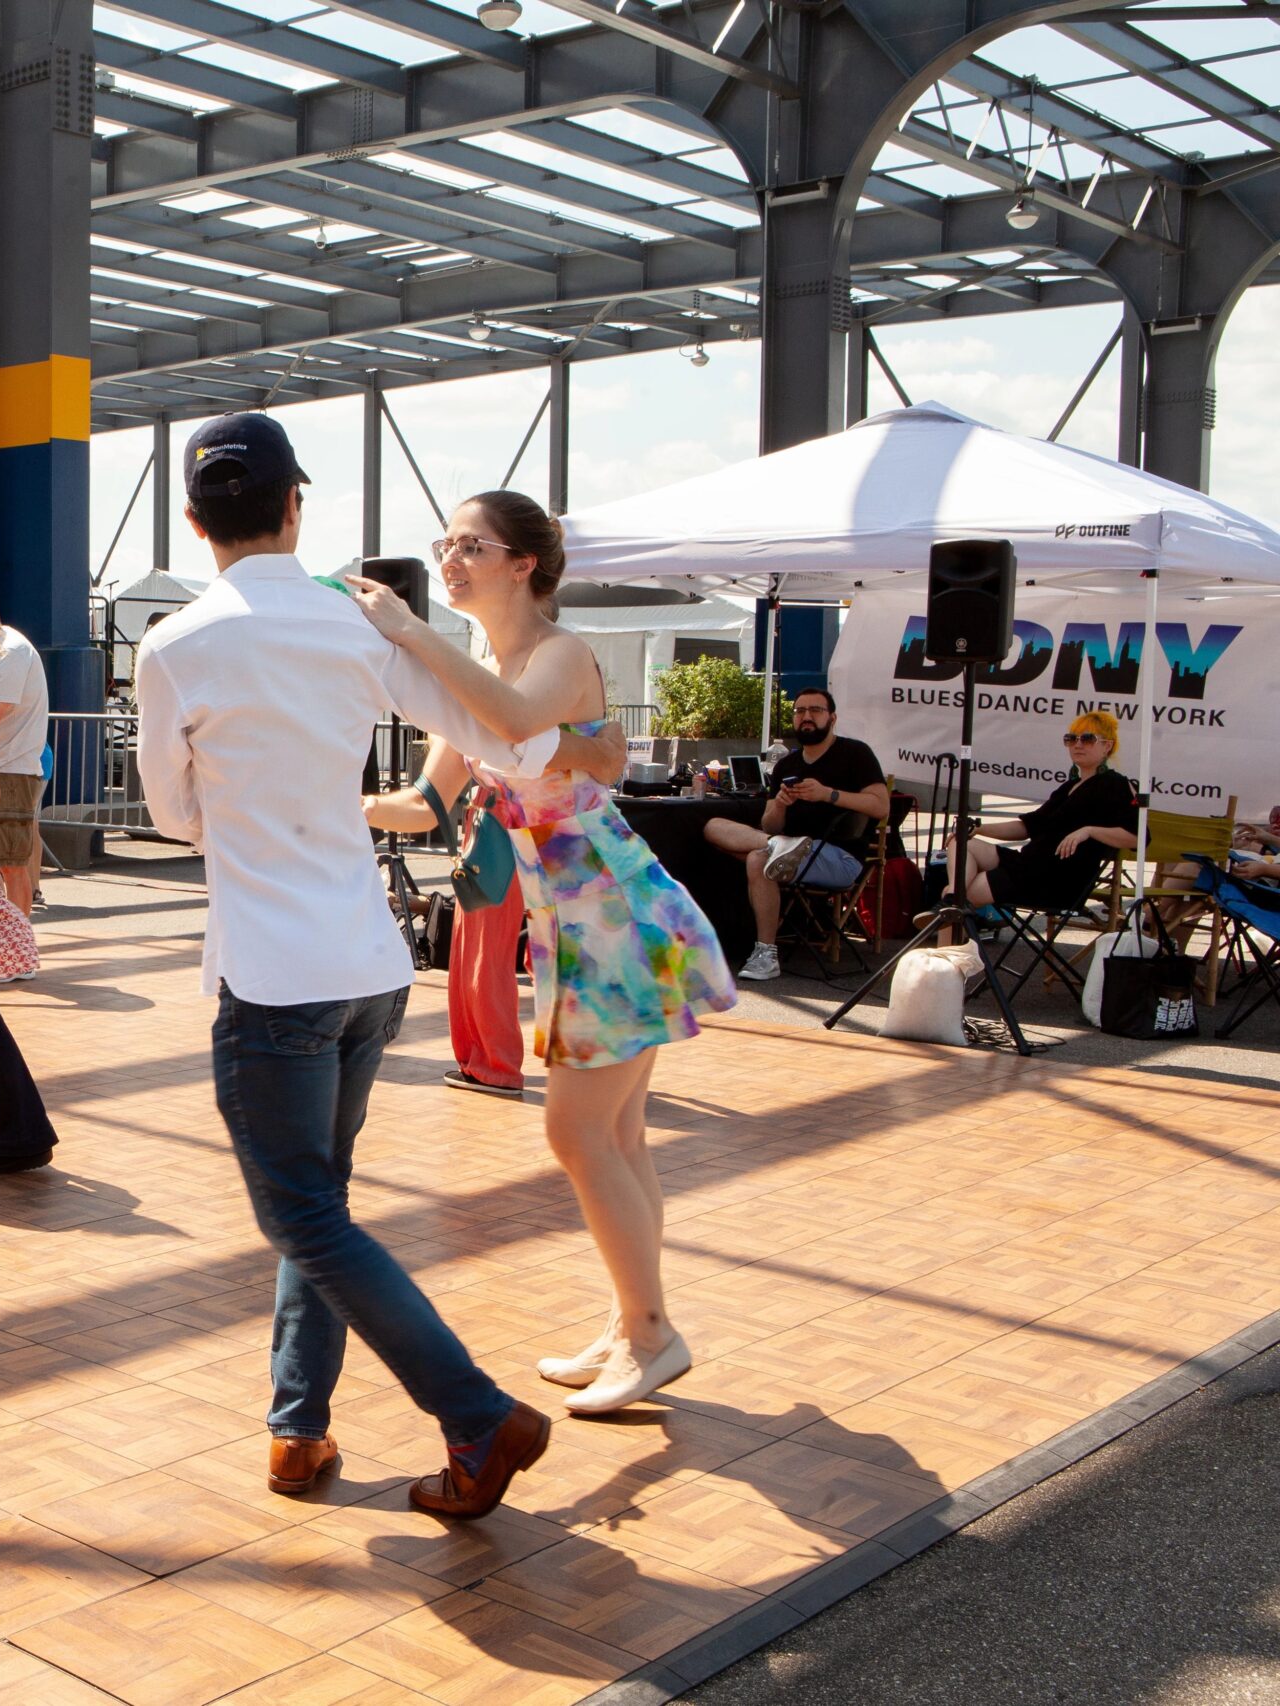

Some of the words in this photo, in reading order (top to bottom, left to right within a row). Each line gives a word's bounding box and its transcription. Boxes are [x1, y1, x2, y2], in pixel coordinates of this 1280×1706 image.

[204, 443, 247, 454] OptionMetrics
[1079, 524, 1131, 537] OUTFINE
[891, 687, 966, 708] BLUES
[978, 692, 1065, 716] DANCE
[1152, 705, 1226, 727] YORK
